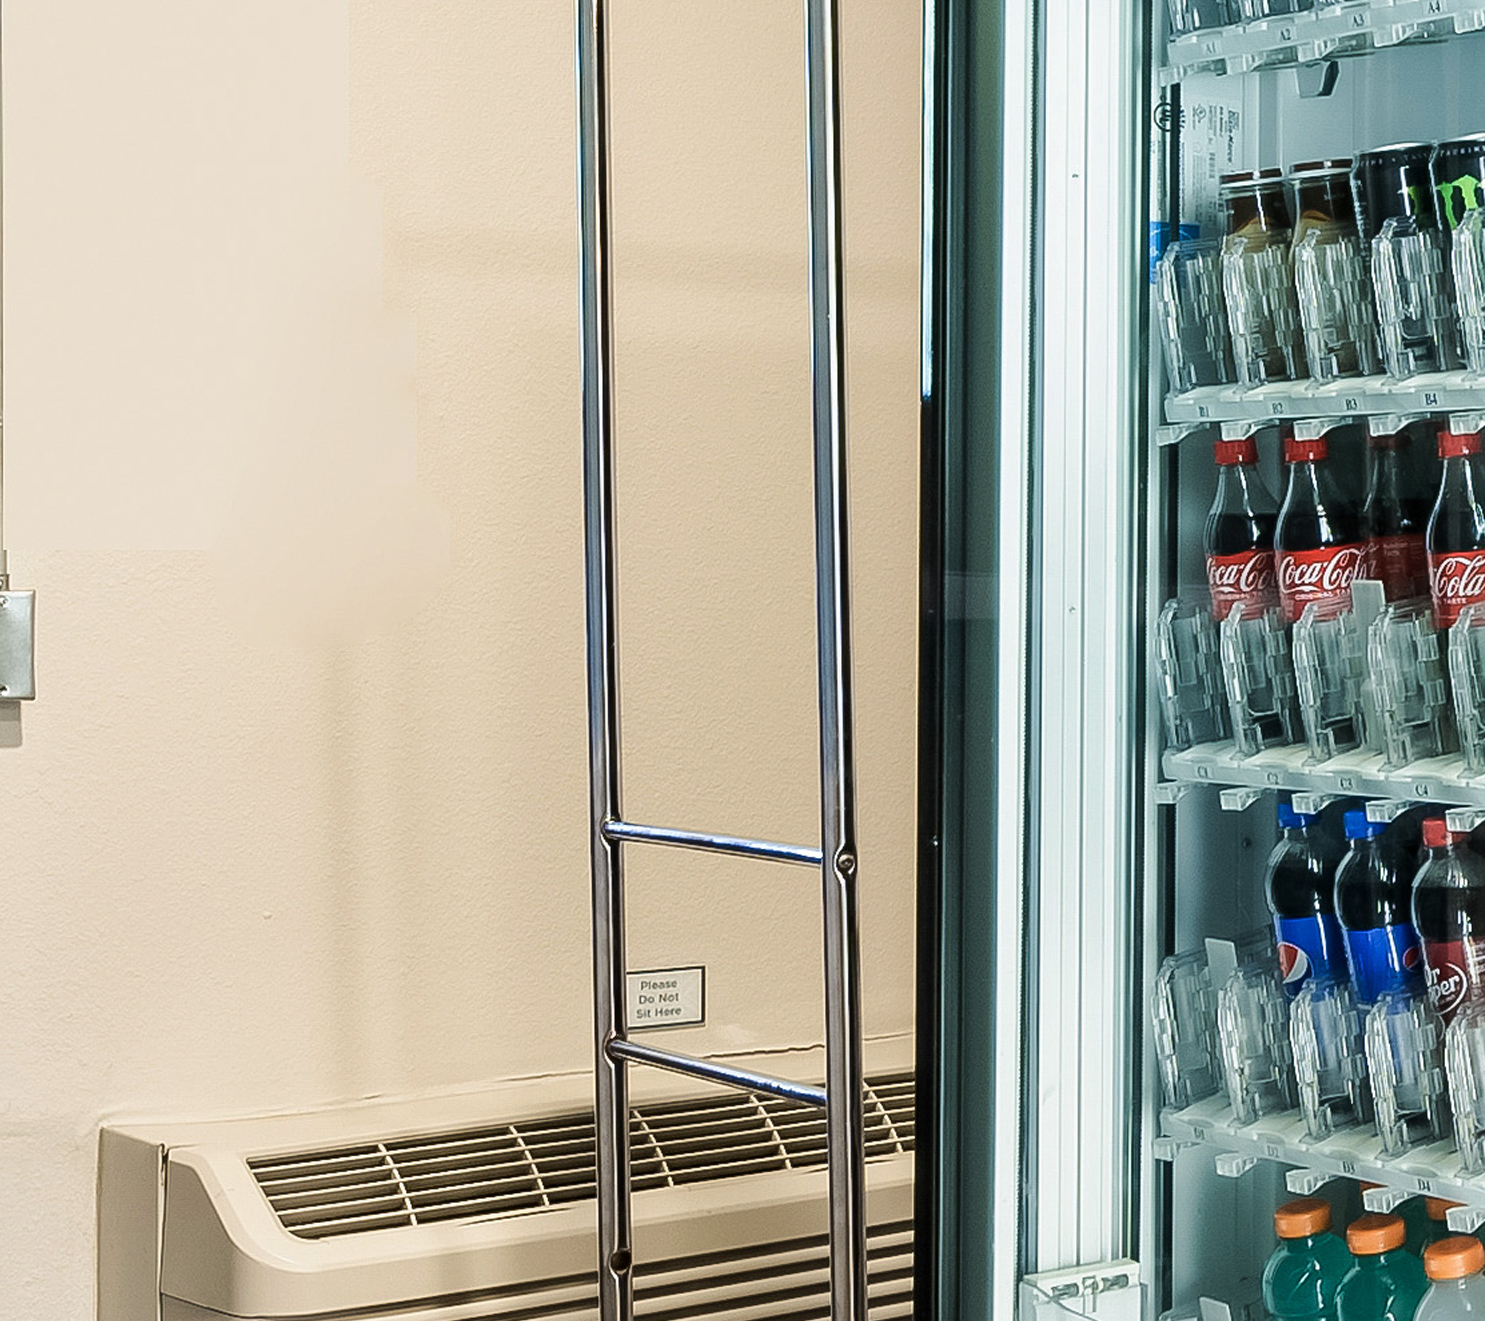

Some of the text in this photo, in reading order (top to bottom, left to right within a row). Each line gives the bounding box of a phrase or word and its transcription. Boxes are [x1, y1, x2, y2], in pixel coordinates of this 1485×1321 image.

[640, 980, 678, 991] Please
[638, 993, 680, 1005] Do Not
[636, 1006, 682, 1019] Sit Here
